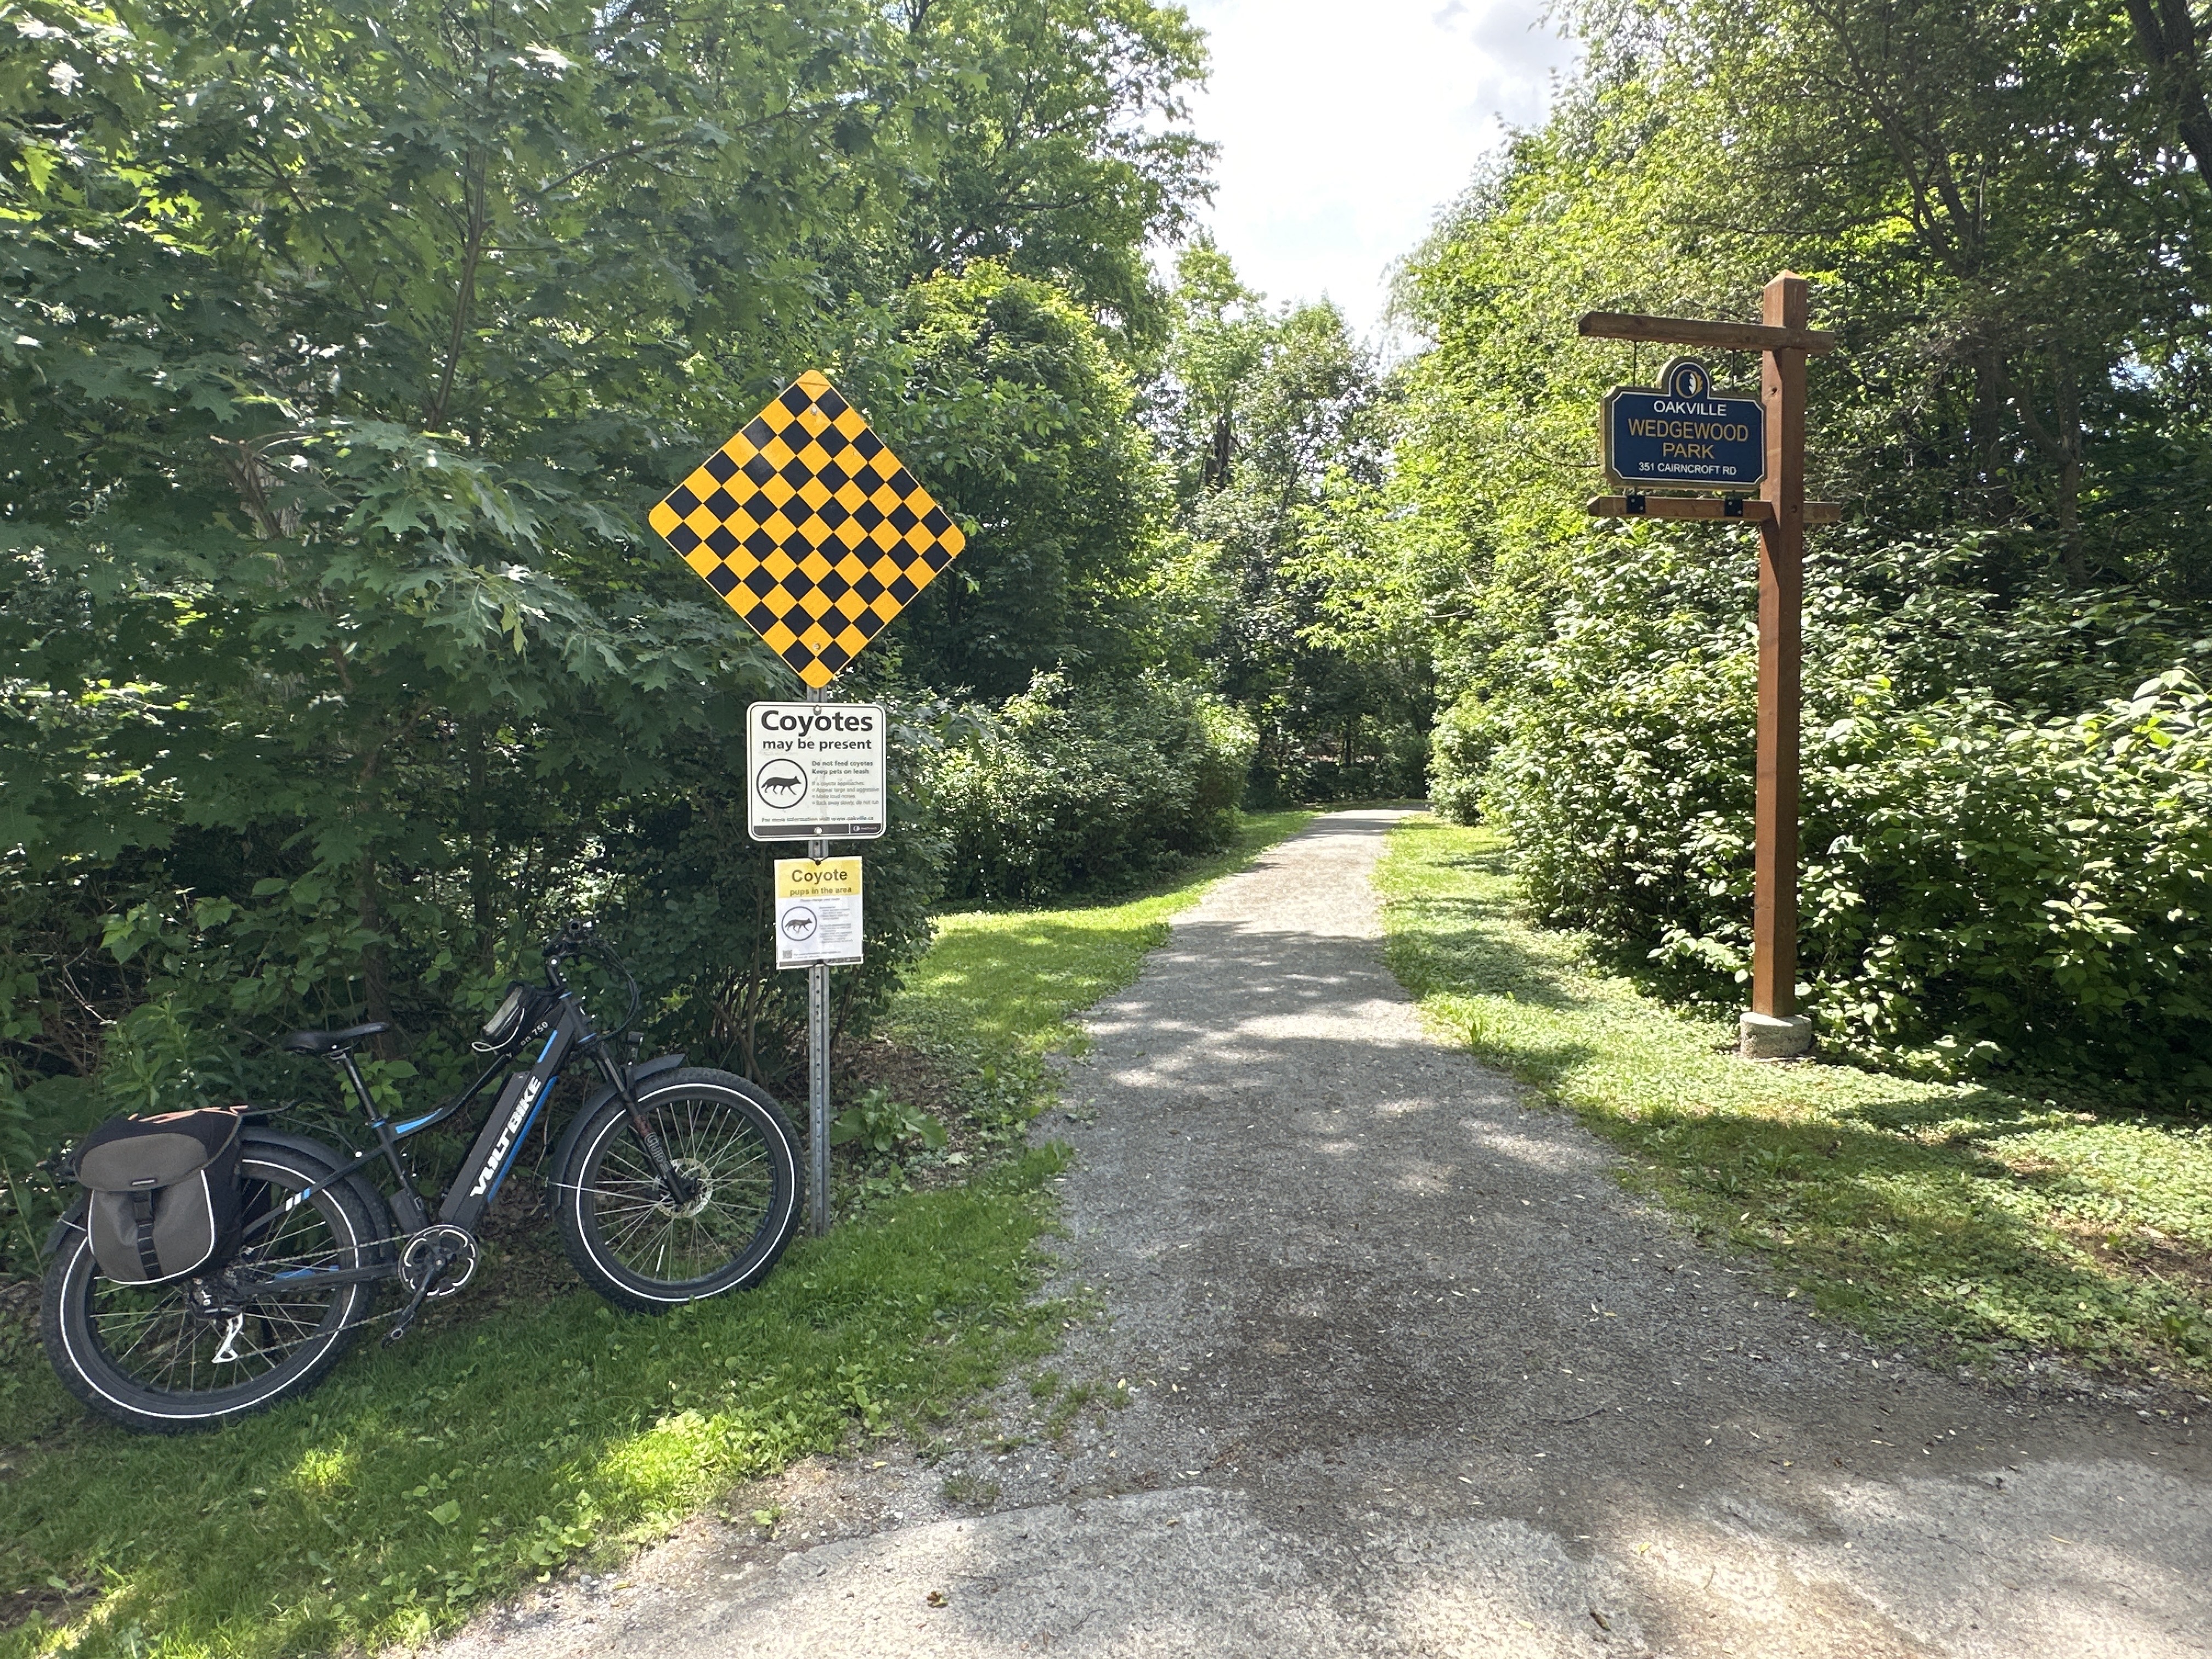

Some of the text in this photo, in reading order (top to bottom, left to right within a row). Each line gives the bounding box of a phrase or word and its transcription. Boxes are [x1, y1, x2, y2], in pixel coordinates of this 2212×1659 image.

[1654, 400, 1727, 416] OAKVILLE
[1628, 418, 1748, 442] WEDGEWOOD
[1662, 442, 1715, 459] PARK
[1638, 462, 1737, 475] 351 CAIRNCROFT RD
[761, 710, 873, 737] Coyotes
[763, 738, 872, 752] may be present
[791, 869, 848, 884] Coyote
[531, 1022, 549, 1036] 750
